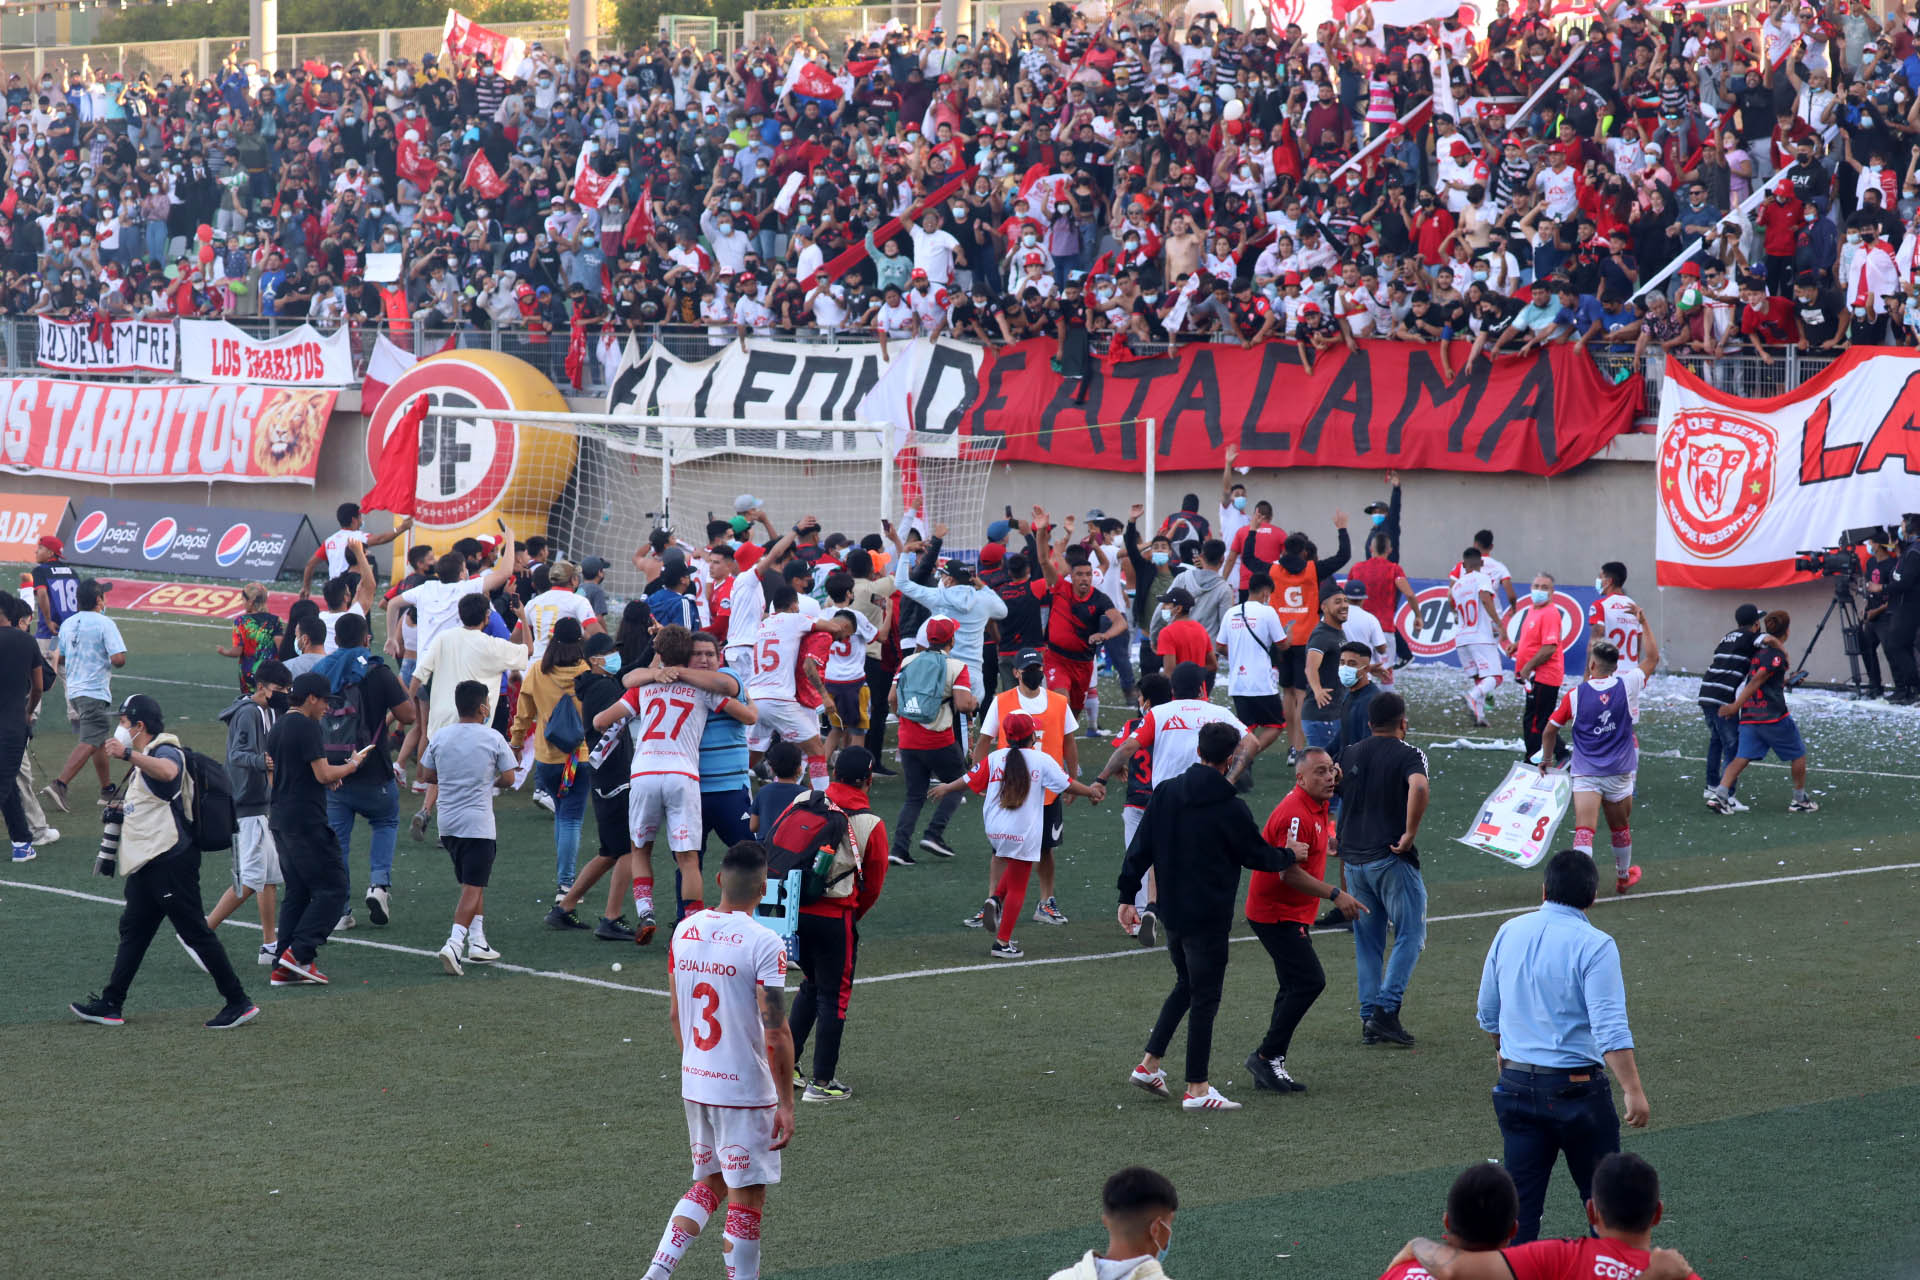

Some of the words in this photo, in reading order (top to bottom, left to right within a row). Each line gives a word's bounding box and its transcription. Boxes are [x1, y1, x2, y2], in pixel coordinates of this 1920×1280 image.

[211, 338, 241, 377] LOS
[1038, 343, 1559, 465] ATACAMA
[42, 382, 264, 474] TARRITOS
[1687, 417, 1715, 431] DE
[103, 528, 140, 544] pepsi
[173, 533, 211, 549] pepsi
[247, 539, 285, 555] pepsi
[51, 579, 78, 612] 18
[149, 585, 248, 614] easy
[1284, 586, 1303, 607] G
[753, 639, 780, 675] 15
[1608, 628, 1639, 662] 20
[642, 698, 695, 742] 27
[1532, 816, 1550, 841] 8
[679, 959, 737, 977] GUAJARDO
[692, 982, 722, 1051] 3
